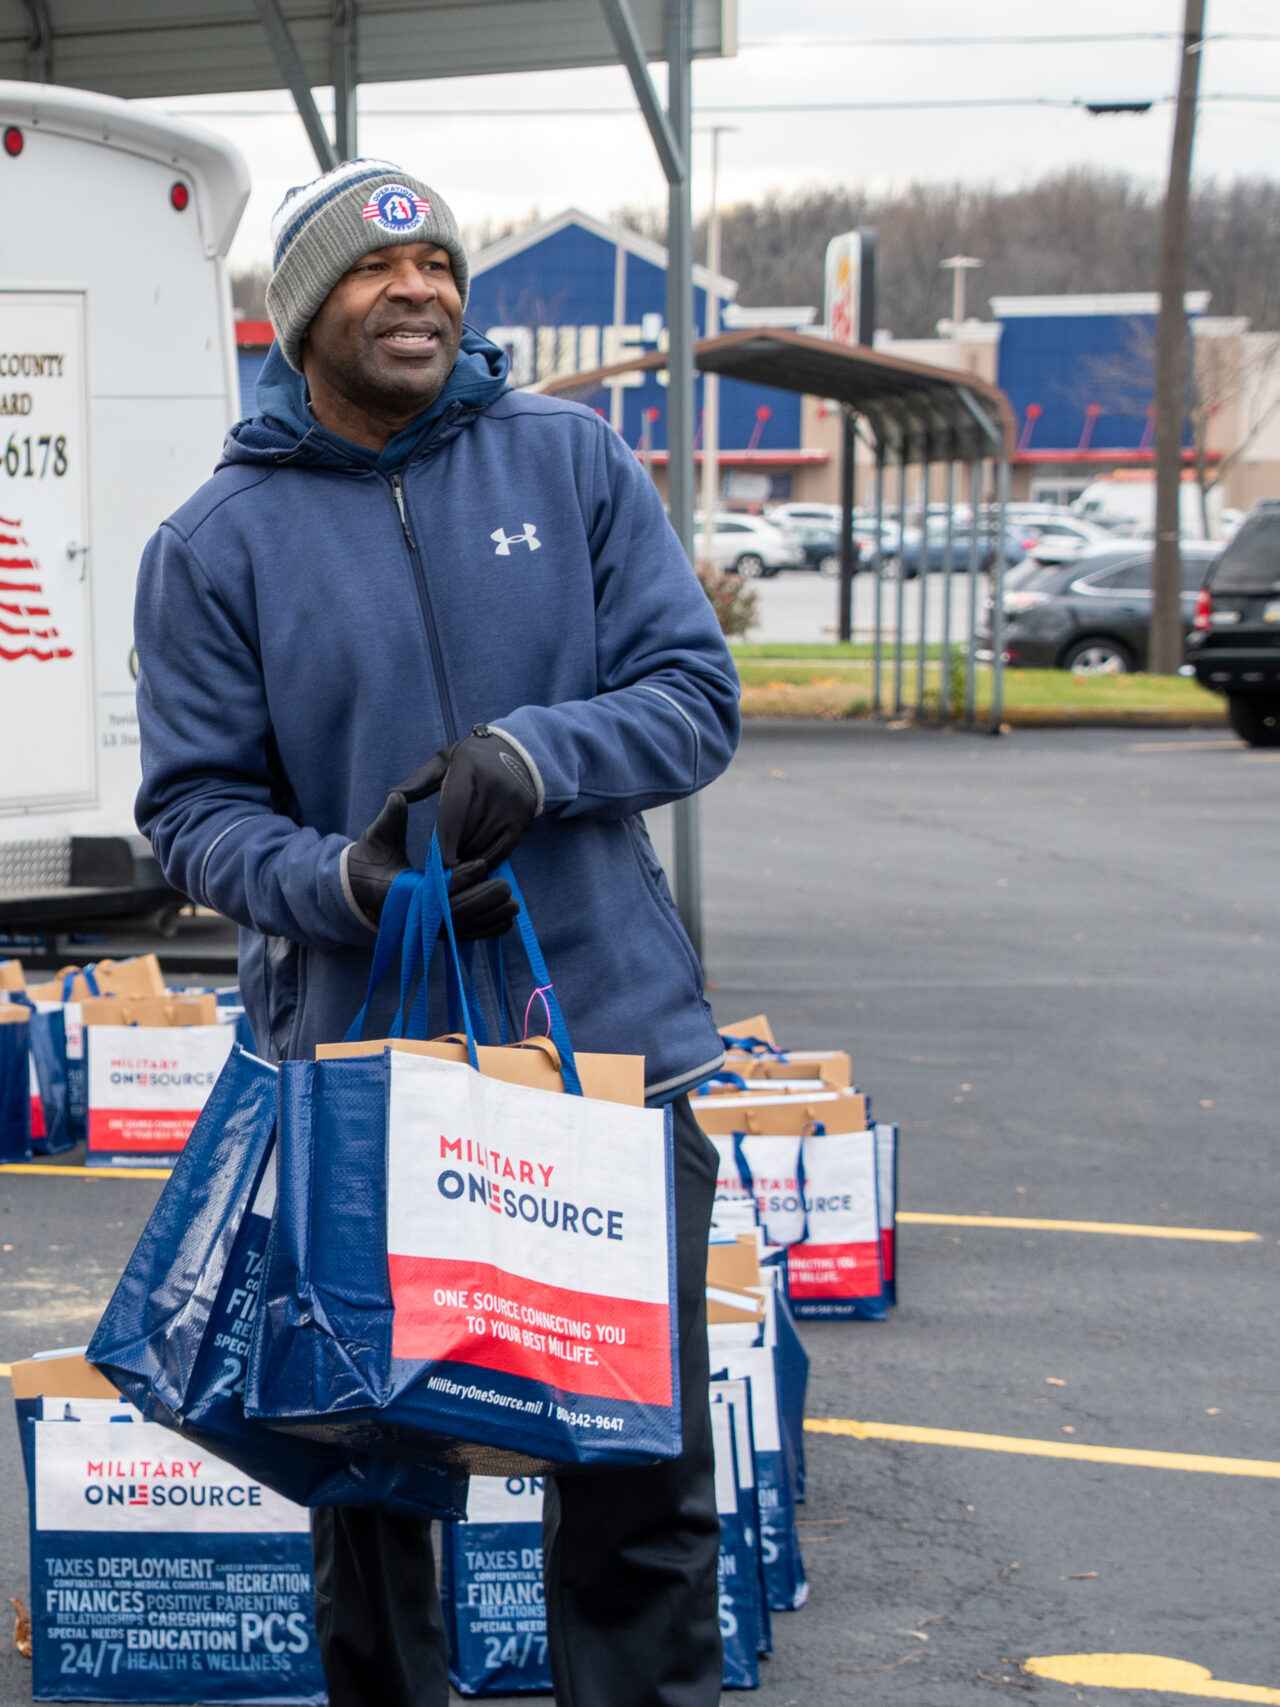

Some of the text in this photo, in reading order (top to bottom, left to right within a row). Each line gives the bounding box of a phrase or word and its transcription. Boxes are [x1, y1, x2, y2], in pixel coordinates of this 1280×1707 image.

[372, 186, 415, 202] OPERATION
[111, 1059, 179, 1070] MILITARY
[439, 1135, 555, 1188] MILITARY
[434, 1289, 626, 1345] ONE SOURCE CONNECTING YOU
[466, 1316, 486, 1336] TO
[490, 1320, 521, 1344] YOUR
[522, 1330, 546, 1352] BEST
[427, 1376, 543, 1415] MilitaryOneSource.mil
[87, 1461, 202, 1478] MILITARY
[45, 1558, 94, 1577] TAXES
[98, 1558, 214, 1579] DEPLOYMENT
[465, 1551, 518, 1570] TAXES
[53, 1579, 112, 1588] CONFIDENTIAL
[172, 1580, 225, 1590] COUNSELING
[226, 1573, 310, 1593] RECREATION
[474, 1571, 536, 1581] CONFIDENTIAL
[46, 1590, 299, 1612] FINANCES POSITIVE PARENTING
[467, 1583, 545, 1606] FINANC
[56, 1612, 237, 1628] RELATIONSHIPS CAREGIVING
[479, 1605, 545, 1619] RELATIONS
[241, 1612, 309, 1653] PCS
[470, 1620, 546, 1633] SPECIAL NEED
[47, 1628, 237, 1651] SPECIAL NEEDS EDUCATION
[60, 1639, 292, 1678] 24/7 HEALTH & WELLNESS
[485, 1633, 548, 1669] 24/7
